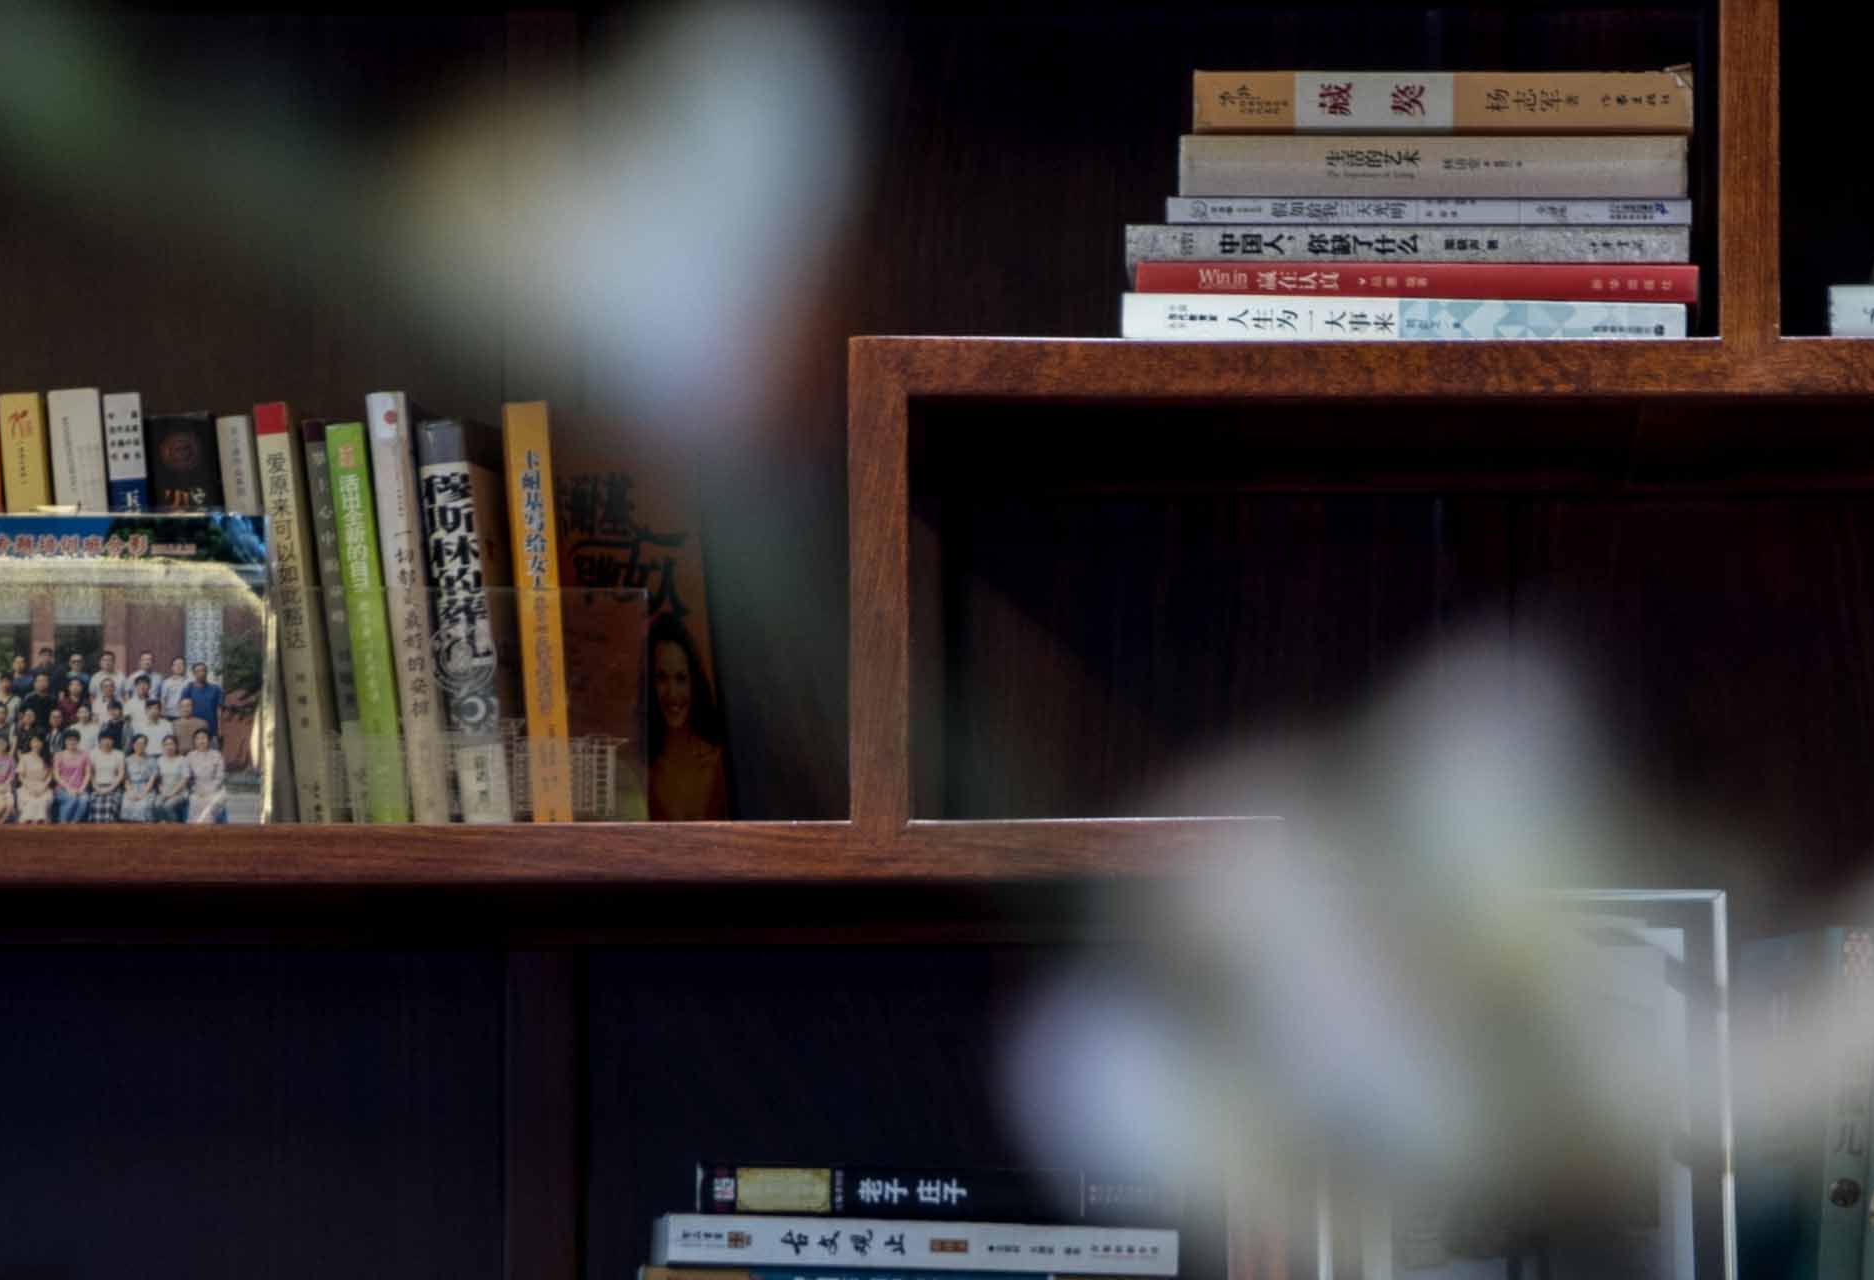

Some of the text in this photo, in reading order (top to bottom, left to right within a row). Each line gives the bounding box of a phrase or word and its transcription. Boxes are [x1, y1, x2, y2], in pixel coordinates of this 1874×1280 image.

[1485, 88, 1561, 113] 杨志军
[1325, 150, 1421, 168] 生活的艺术
[1270, 201, 1407, 219] 假如给我三天光明
[1256, 271, 1340, 289] 赢在认真
[1228, 310, 1395, 332] 人生为一大事来
[858, 1177, 968, 1206] 老子 庄子
[780, 1228, 906, 1256] 古文观止
